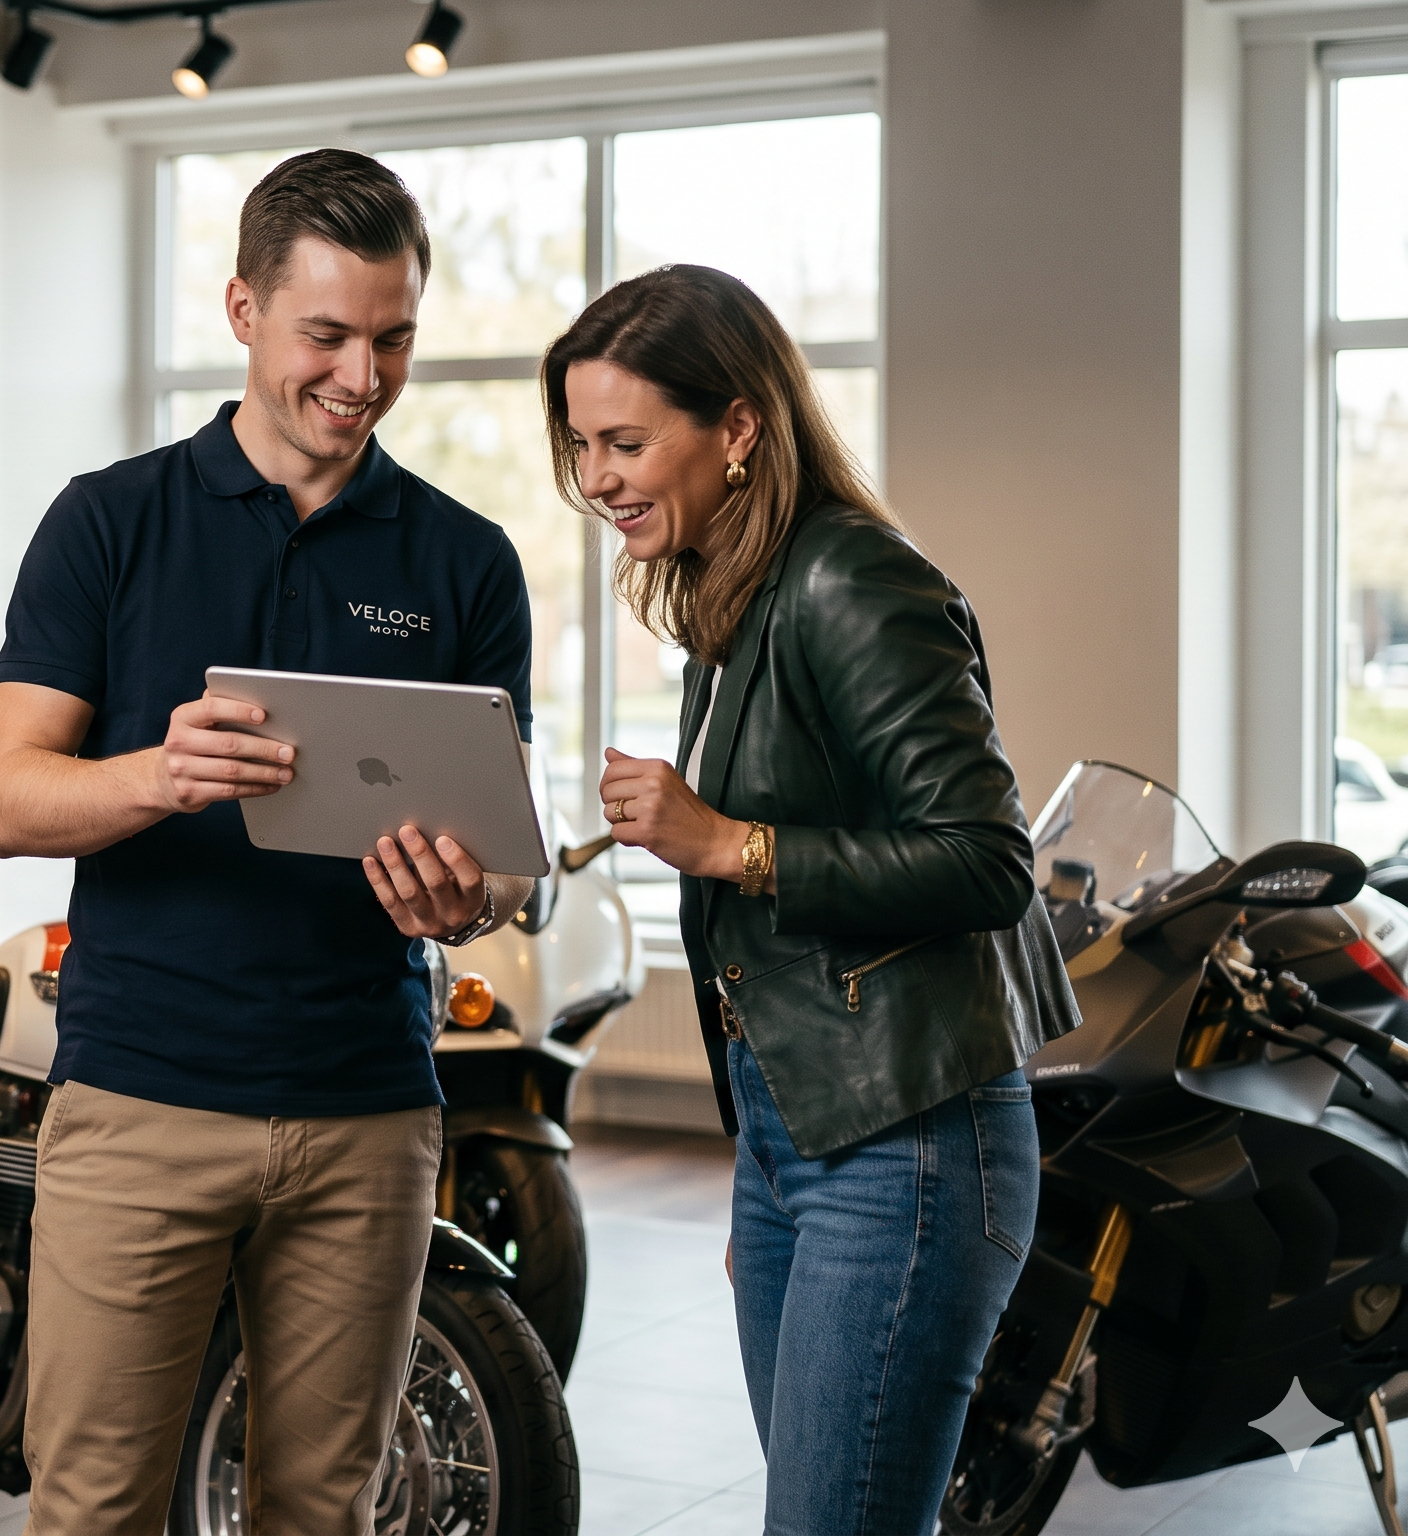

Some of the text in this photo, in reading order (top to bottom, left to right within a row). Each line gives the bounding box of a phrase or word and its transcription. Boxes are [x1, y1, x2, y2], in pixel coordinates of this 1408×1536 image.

[348, 601, 431, 632] VELOCE
[370, 625, 409, 638] MOTO
[1035, 1063, 1080, 1078] DUCATI
